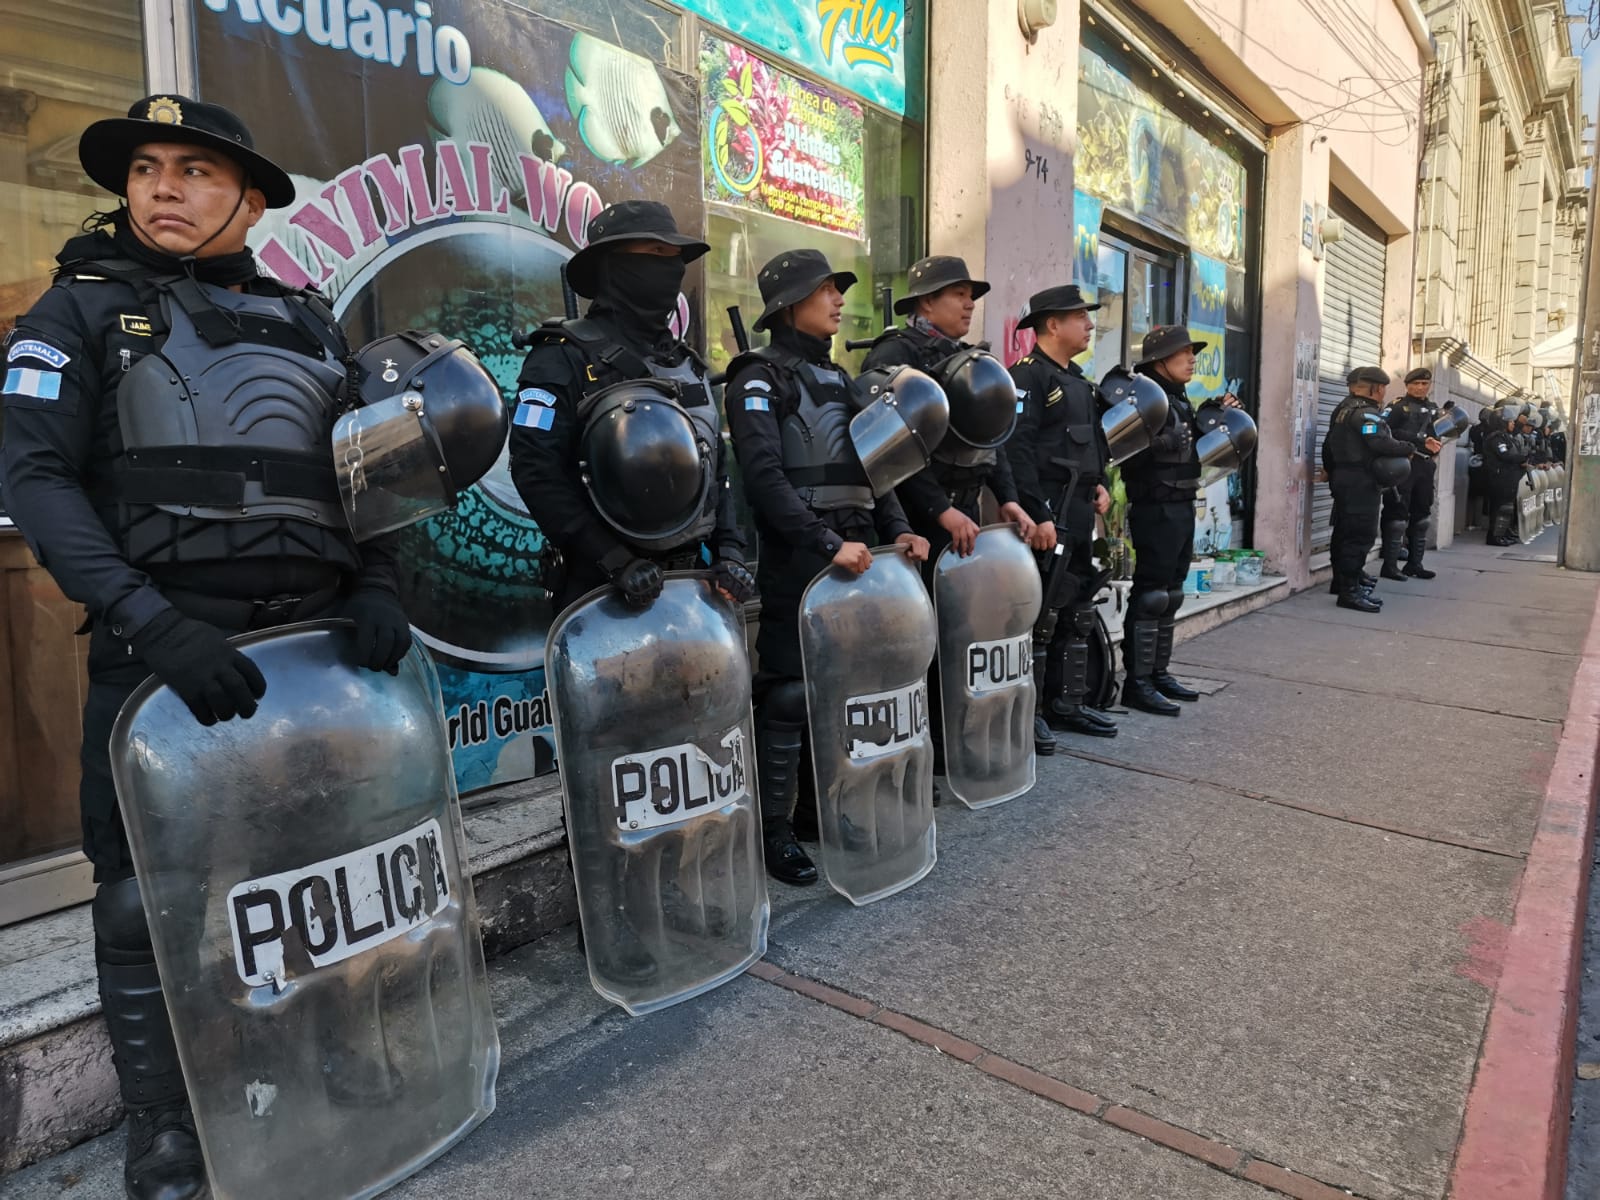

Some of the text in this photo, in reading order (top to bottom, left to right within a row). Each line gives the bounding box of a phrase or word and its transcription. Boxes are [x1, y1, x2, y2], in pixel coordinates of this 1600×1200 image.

[203, 0, 472, 85] cuario
[969, 639, 1030, 687] POLIC
[446, 687, 553, 751] rld Guat
[847, 684, 924, 752] POLIC
